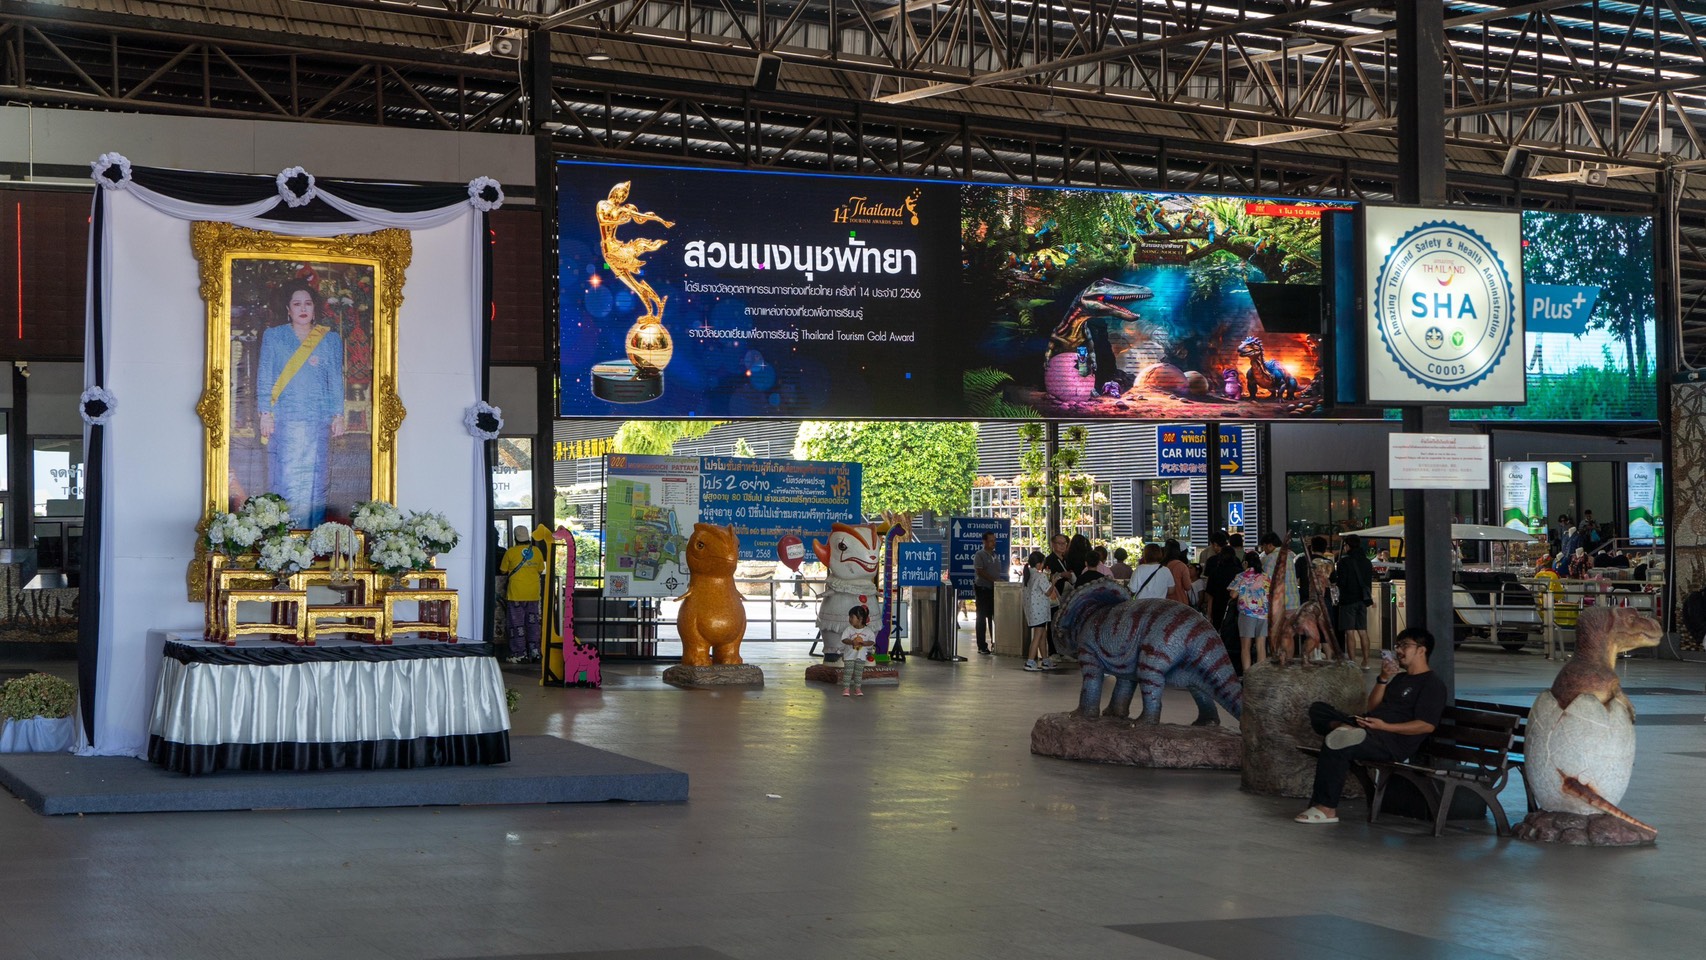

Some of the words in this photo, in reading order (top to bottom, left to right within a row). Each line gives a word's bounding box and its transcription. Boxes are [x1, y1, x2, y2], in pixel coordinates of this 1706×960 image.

[849, 196, 905, 218] Thailand
[1415, 237, 1442, 253] Safety
[1446, 237, 1453, 247] &
[684, 236, 917, 281] สวนนงนุชพัทยา
[1458, 241, 1482, 265] Health
[1389, 250, 1414, 287] Thailand
[1422, 264, 1466, 274] THAILAND
[684, 281, 832, 298] ได้รับรางวัลอุตสาหกรรมการท่องเที่ยวไทย
[835, 284, 857, 297] ครั้งที่
[859, 288, 869, 298] 14
[872, 287, 897, 299] ประจำปี
[900, 288, 921, 299] 2566
[1411, 291, 1478, 320] SHA
[1483, 266, 1501, 338] Administration
[744, 304, 863, 320] สาขาแหล่งท่องเที่ยวเพื่อการเรียนรู้
[1387, 294, 1402, 336] Amazing
[689, 327, 799, 342] รางวัลยอดเยี่ยมเพื่อการเรียนรู้
[801, 330, 832, 340] Thailand
[837, 331, 864, 341] Tourism
[867, 331, 886, 341] Gold
[889, 331, 914, 341] Award
[1427, 363, 1466, 376] C0003
[1232, 434, 1237, 443] 1
[1162, 448, 1182, 458] CAR
[1185, 448, 1229, 458] MUSM
[1232, 448, 1239, 458] 1
[700, 473, 722, 490] โปร
[725, 475, 737, 490] 2
[739, 476, 770, 490] อย่าง
[1508, 472, 1524, 480] Chang
[831, 475, 851, 497] ฟรี!
[703, 505, 732, 520] ผู้สูงอายุ
[735, 507, 746, 517] 60
[748, 503, 848, 523] ปีขึ้นไปเข้าชมสวนฟรีทุกวันศุกร์
[967, 521, 1003, 530] สวนลอยฟ้า
[756, 549, 771, 559] 2568
[905, 547, 937, 561] ทางเข้า
[902, 566, 939, 581] สำหรับเด็ก
